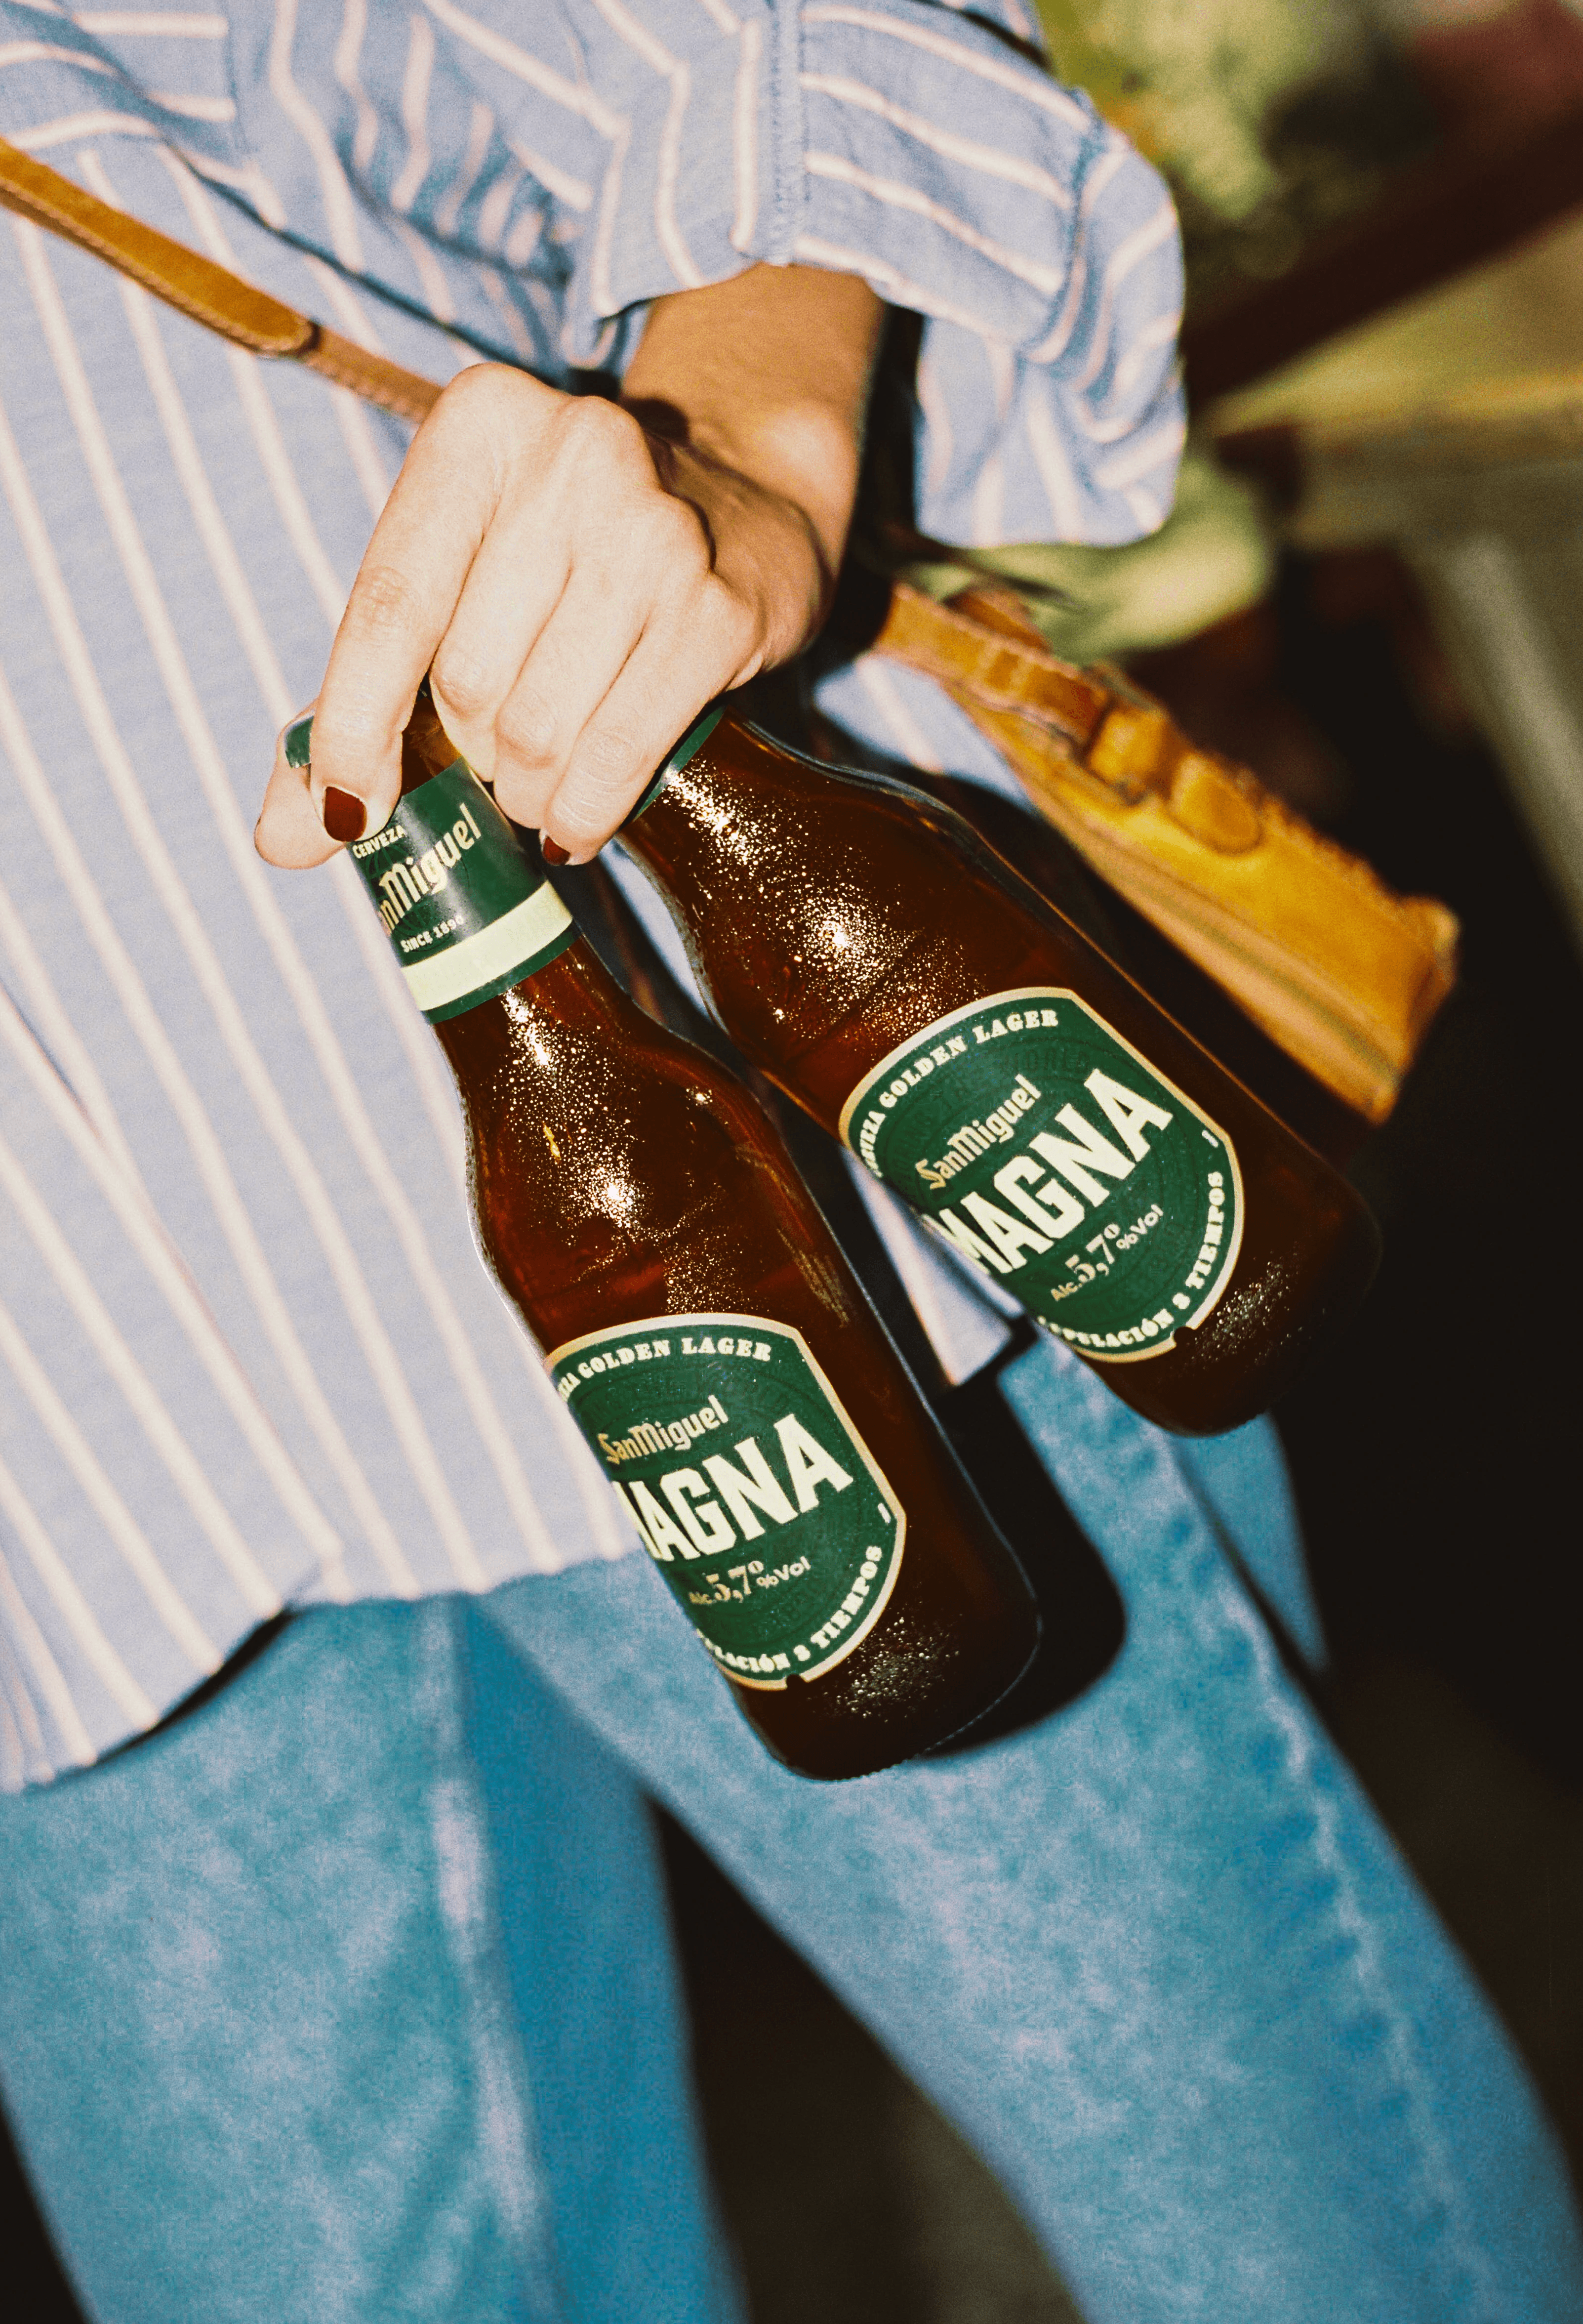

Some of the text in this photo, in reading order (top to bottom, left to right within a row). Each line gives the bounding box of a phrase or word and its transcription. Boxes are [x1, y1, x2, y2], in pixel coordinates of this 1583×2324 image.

[352, 825, 407, 859] CERVEZA
[378, 802, 482, 932] nMiguel
[879, 1035, 967, 1108] GOLDEN
[972, 1009, 1058, 1043] LAGER
[1185, 1171, 1225, 1289] TIEMPOS
[578, 1336, 771, 1378] GOLDEN LAGER
[810, 1546, 882, 1649] TIEMPOS
